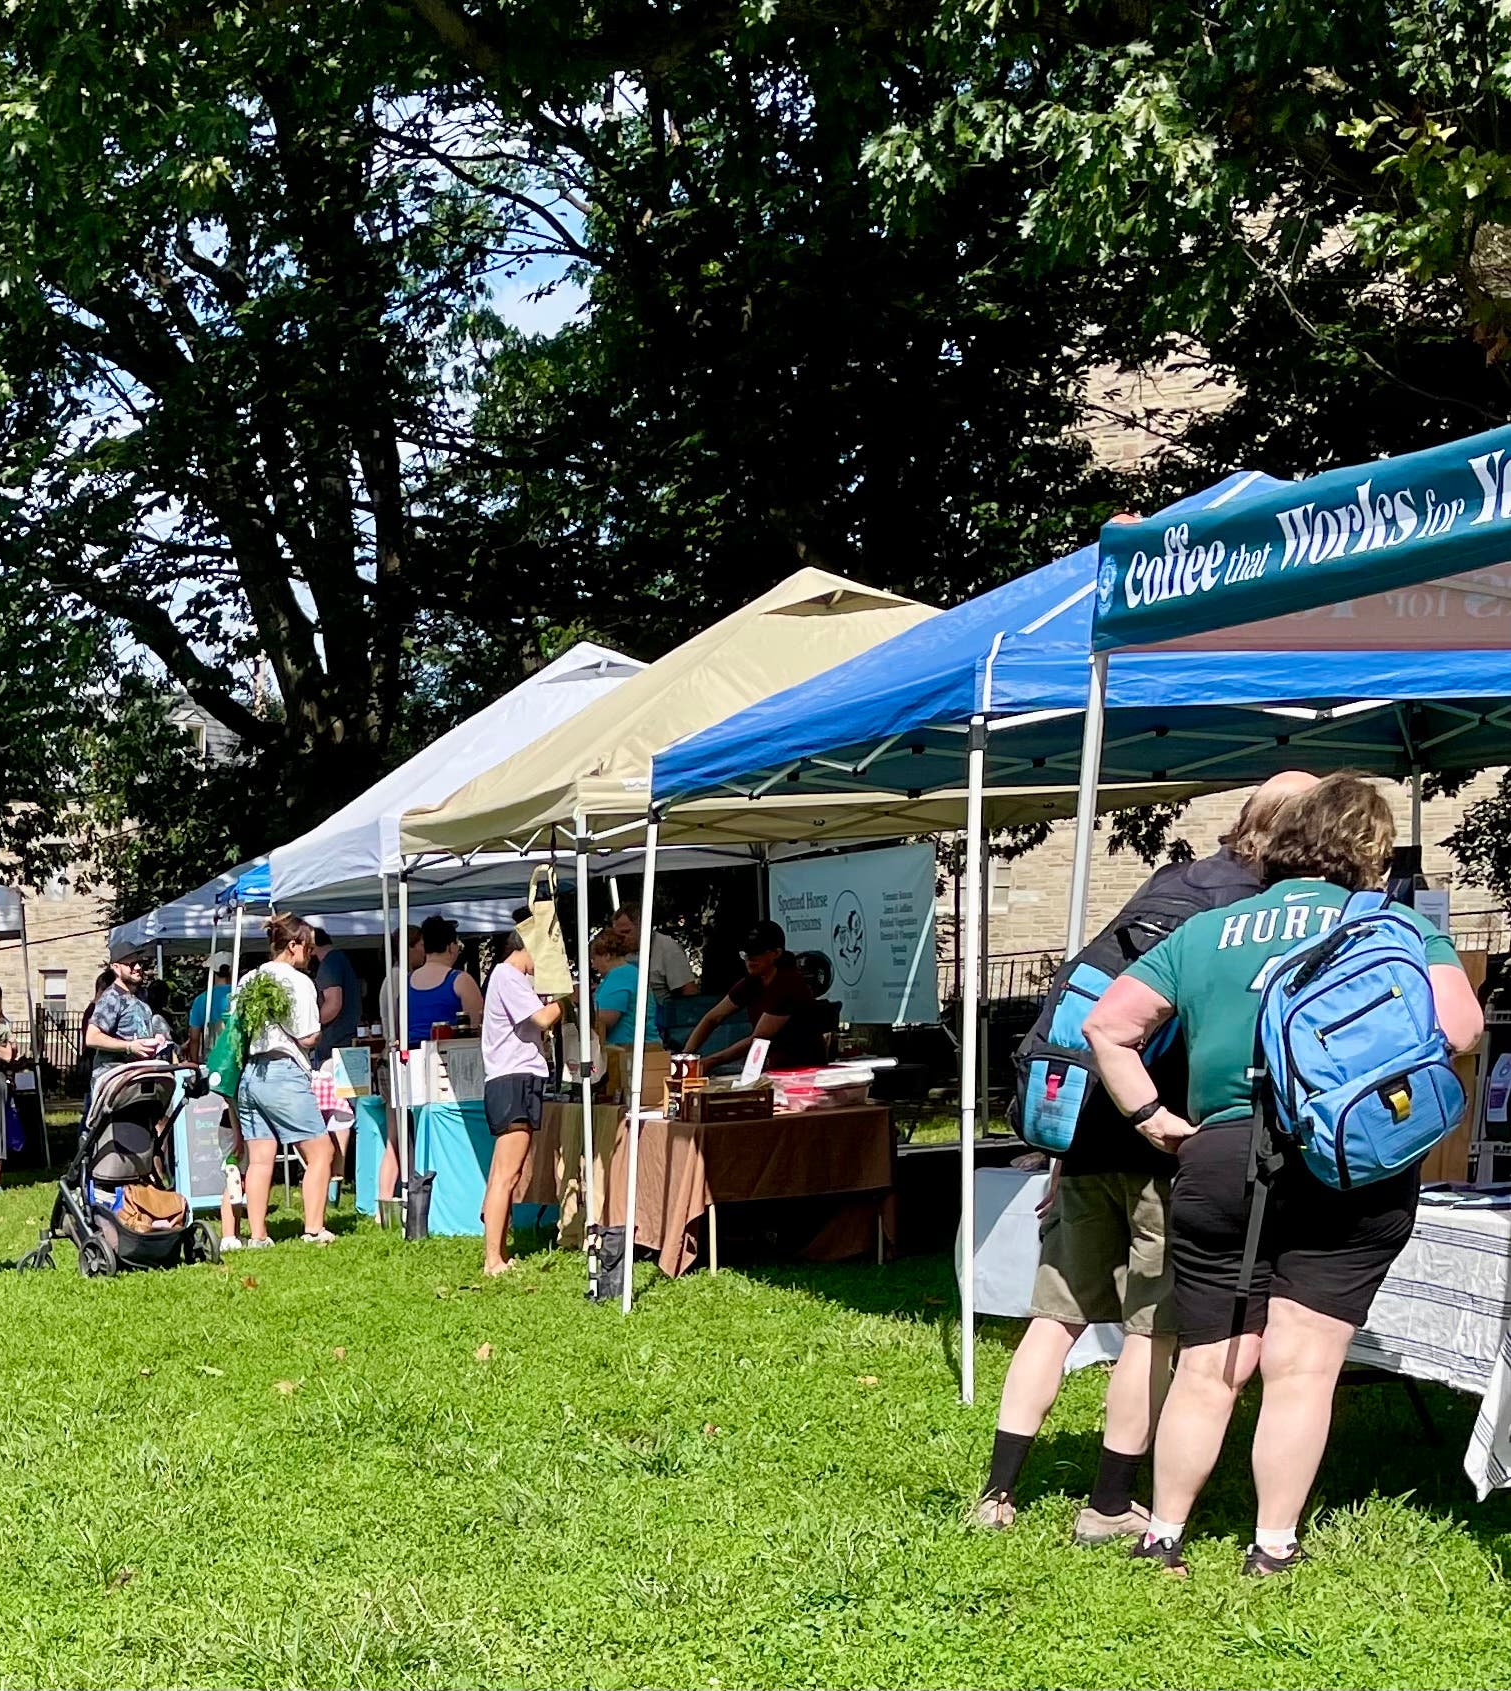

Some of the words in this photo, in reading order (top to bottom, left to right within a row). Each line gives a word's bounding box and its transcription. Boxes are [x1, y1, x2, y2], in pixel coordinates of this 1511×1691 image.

[1124, 522, 1226, 609] Coffee
[1223, 542, 1273, 585] that
[1276, 479, 1416, 571] Works
[1415, 488, 1466, 539] for
[1217, 905, 1342, 949] HURT
